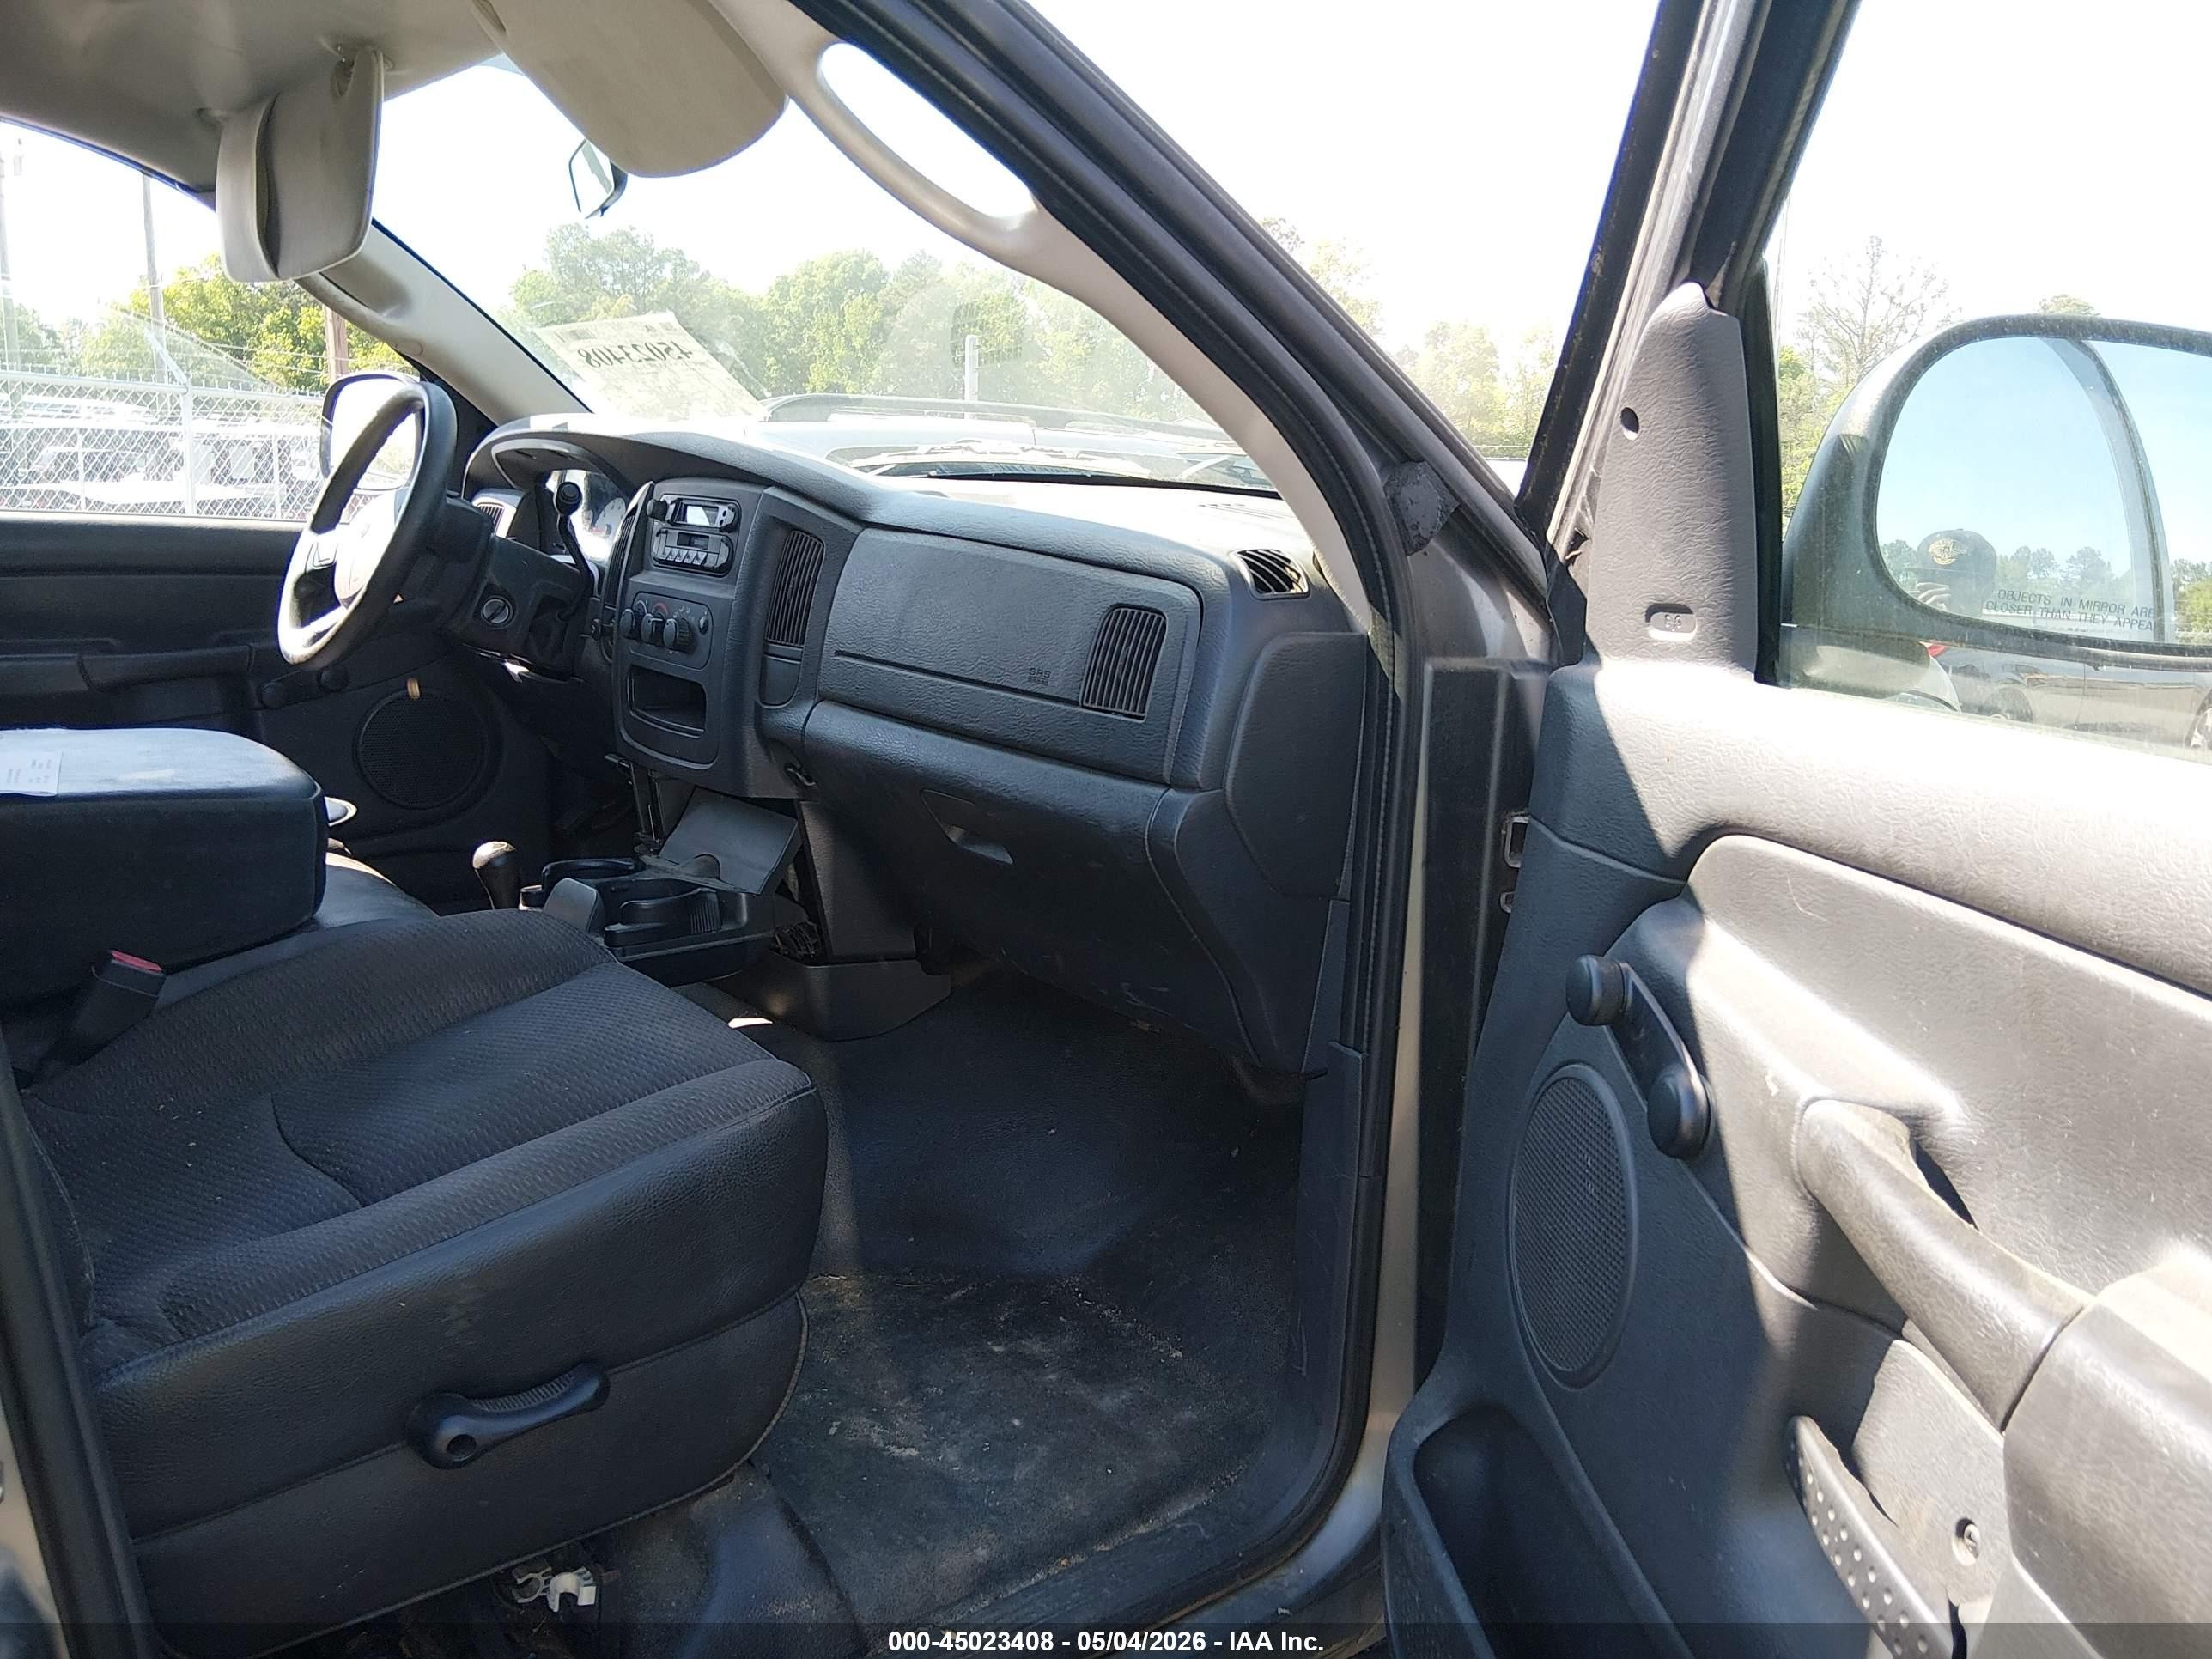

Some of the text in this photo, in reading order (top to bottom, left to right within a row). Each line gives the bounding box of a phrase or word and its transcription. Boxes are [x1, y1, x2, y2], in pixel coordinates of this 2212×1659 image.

[1985, 600, 2157, 631] CLOSER THAN THEY APPEA
[1997, 589, 2155, 618] OBJECTS IN MIRROR ARE
